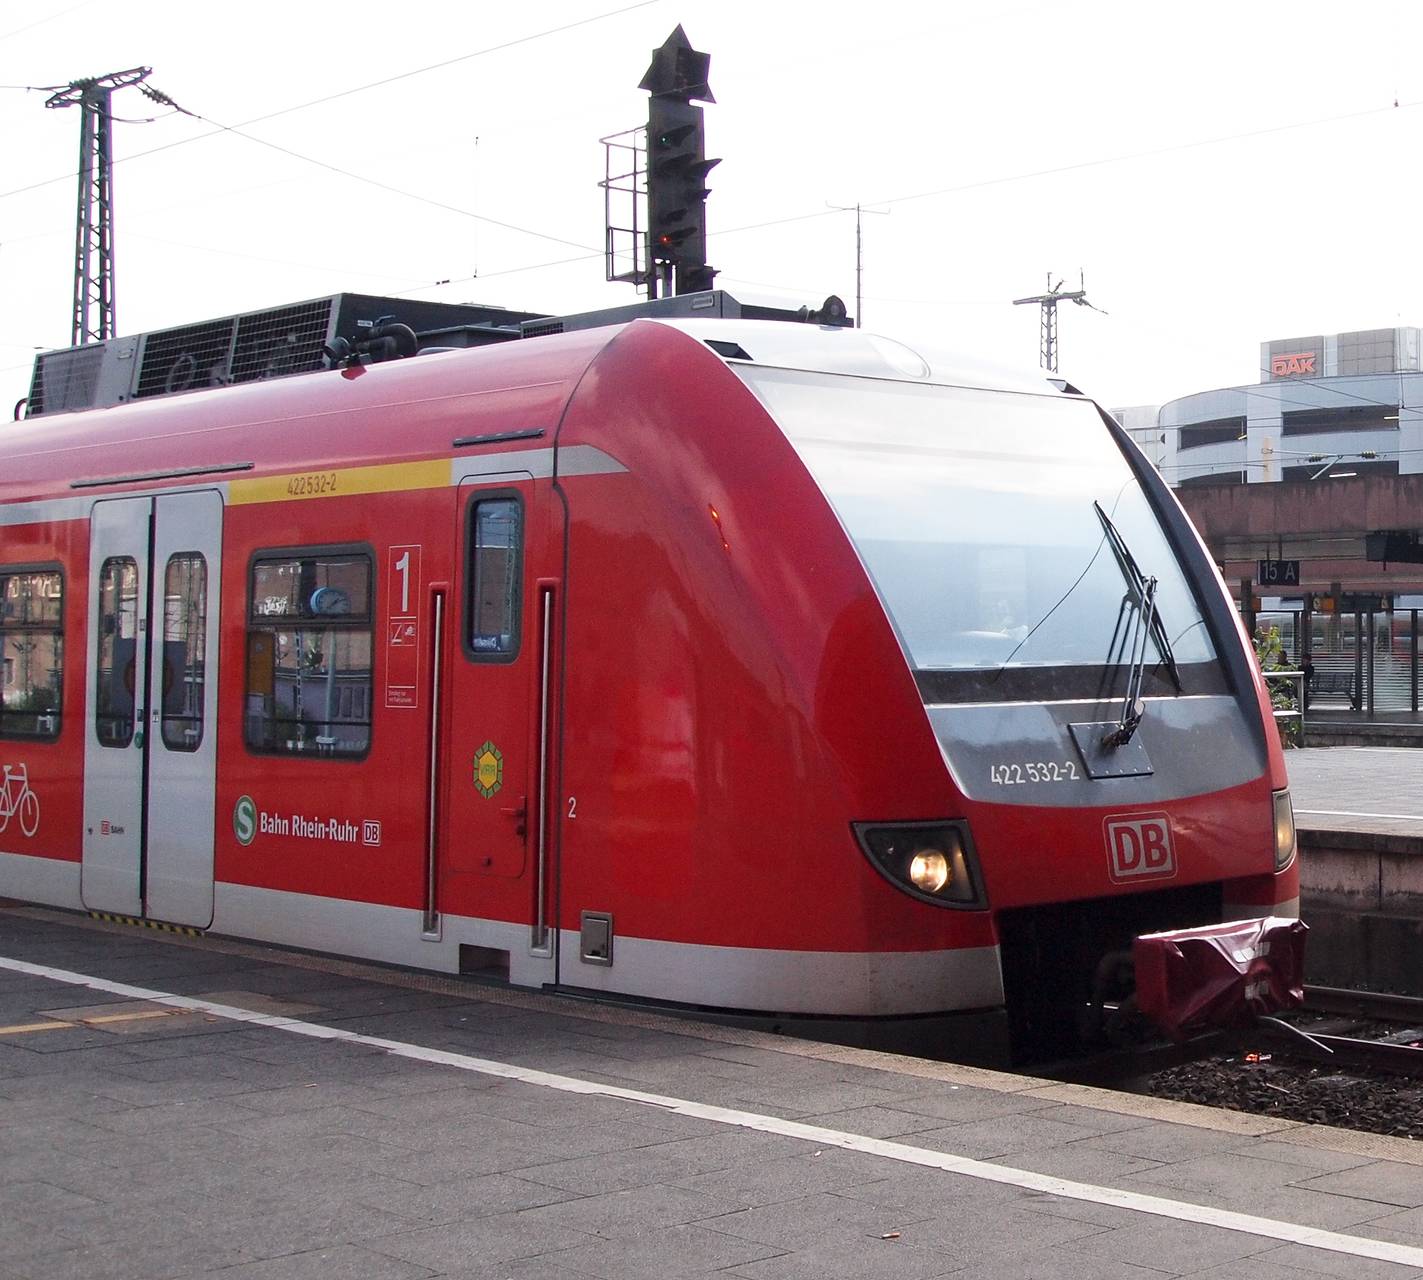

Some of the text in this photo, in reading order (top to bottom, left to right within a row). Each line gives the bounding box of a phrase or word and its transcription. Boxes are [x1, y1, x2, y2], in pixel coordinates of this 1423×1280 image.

[1271, 352, 1315, 376] DAK
[395, 552, 410, 612] 1
[1263, 561, 1296, 580] 15 A
[237, 801, 380, 843] S Bahn Rhein-Ruhr DB
[567, 796, 577, 818] 2
[1110, 821, 1171, 874] DB
